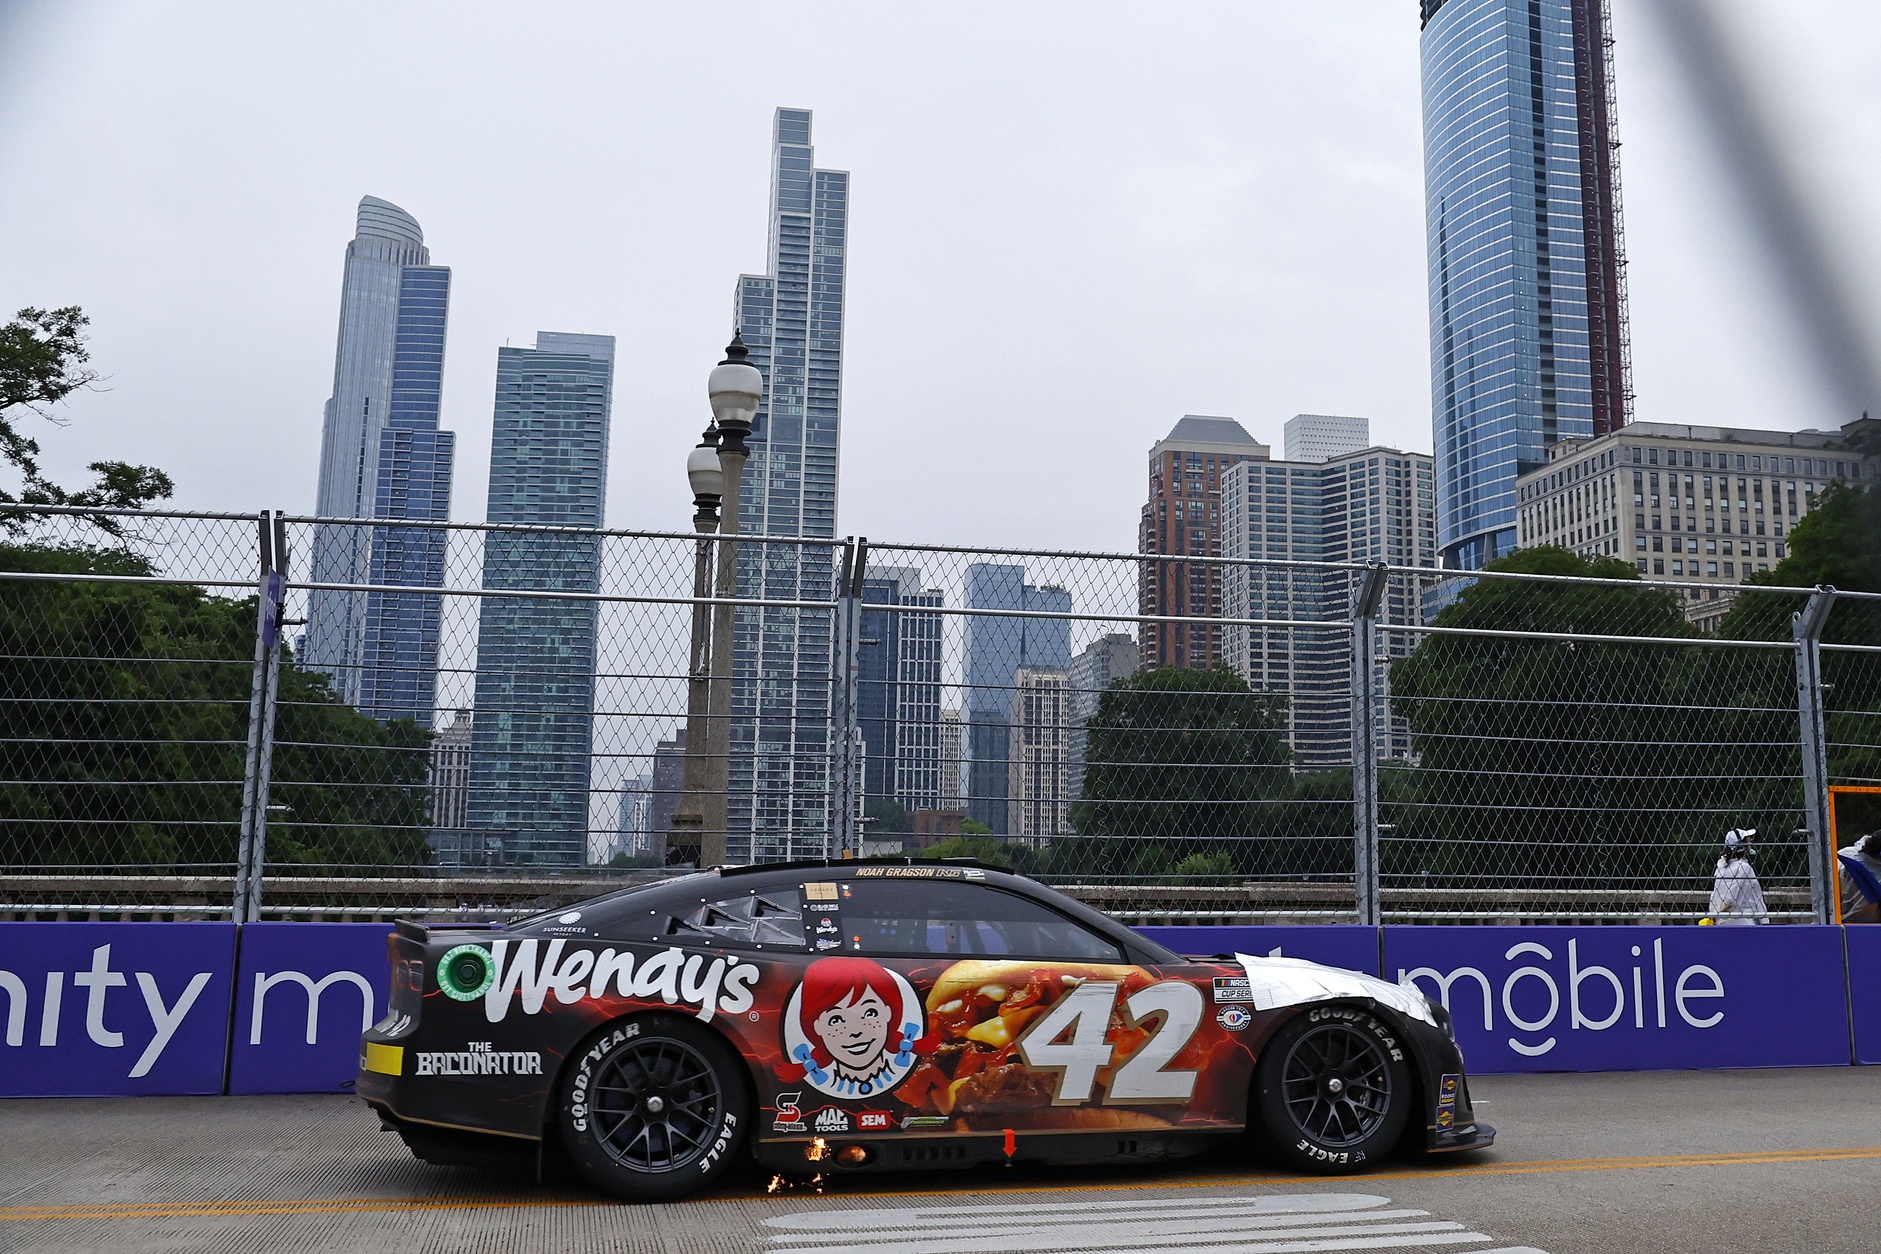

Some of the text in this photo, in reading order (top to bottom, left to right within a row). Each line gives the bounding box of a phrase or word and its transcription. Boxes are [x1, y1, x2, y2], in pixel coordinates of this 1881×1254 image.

[856, 867, 884, 876] NOAH
[885, 868, 935, 877] GRAGSON
[542, 926, 587, 934] SUNSEEKER
[485, 939, 760, 1023] Wendy's
[1221, 990, 1236, 998] CUP
[468, 1041, 492, 1052] THE
[1016, 980, 1205, 1106] 42
[415, 1051, 544, 1076] BACONATOR
[815, 1108, 848, 1126] MAC
[861, 1114, 886, 1126] SEM
[699, 1111, 737, 1174] EAGLE
[1296, 1138, 1349, 1164] EAGLE
